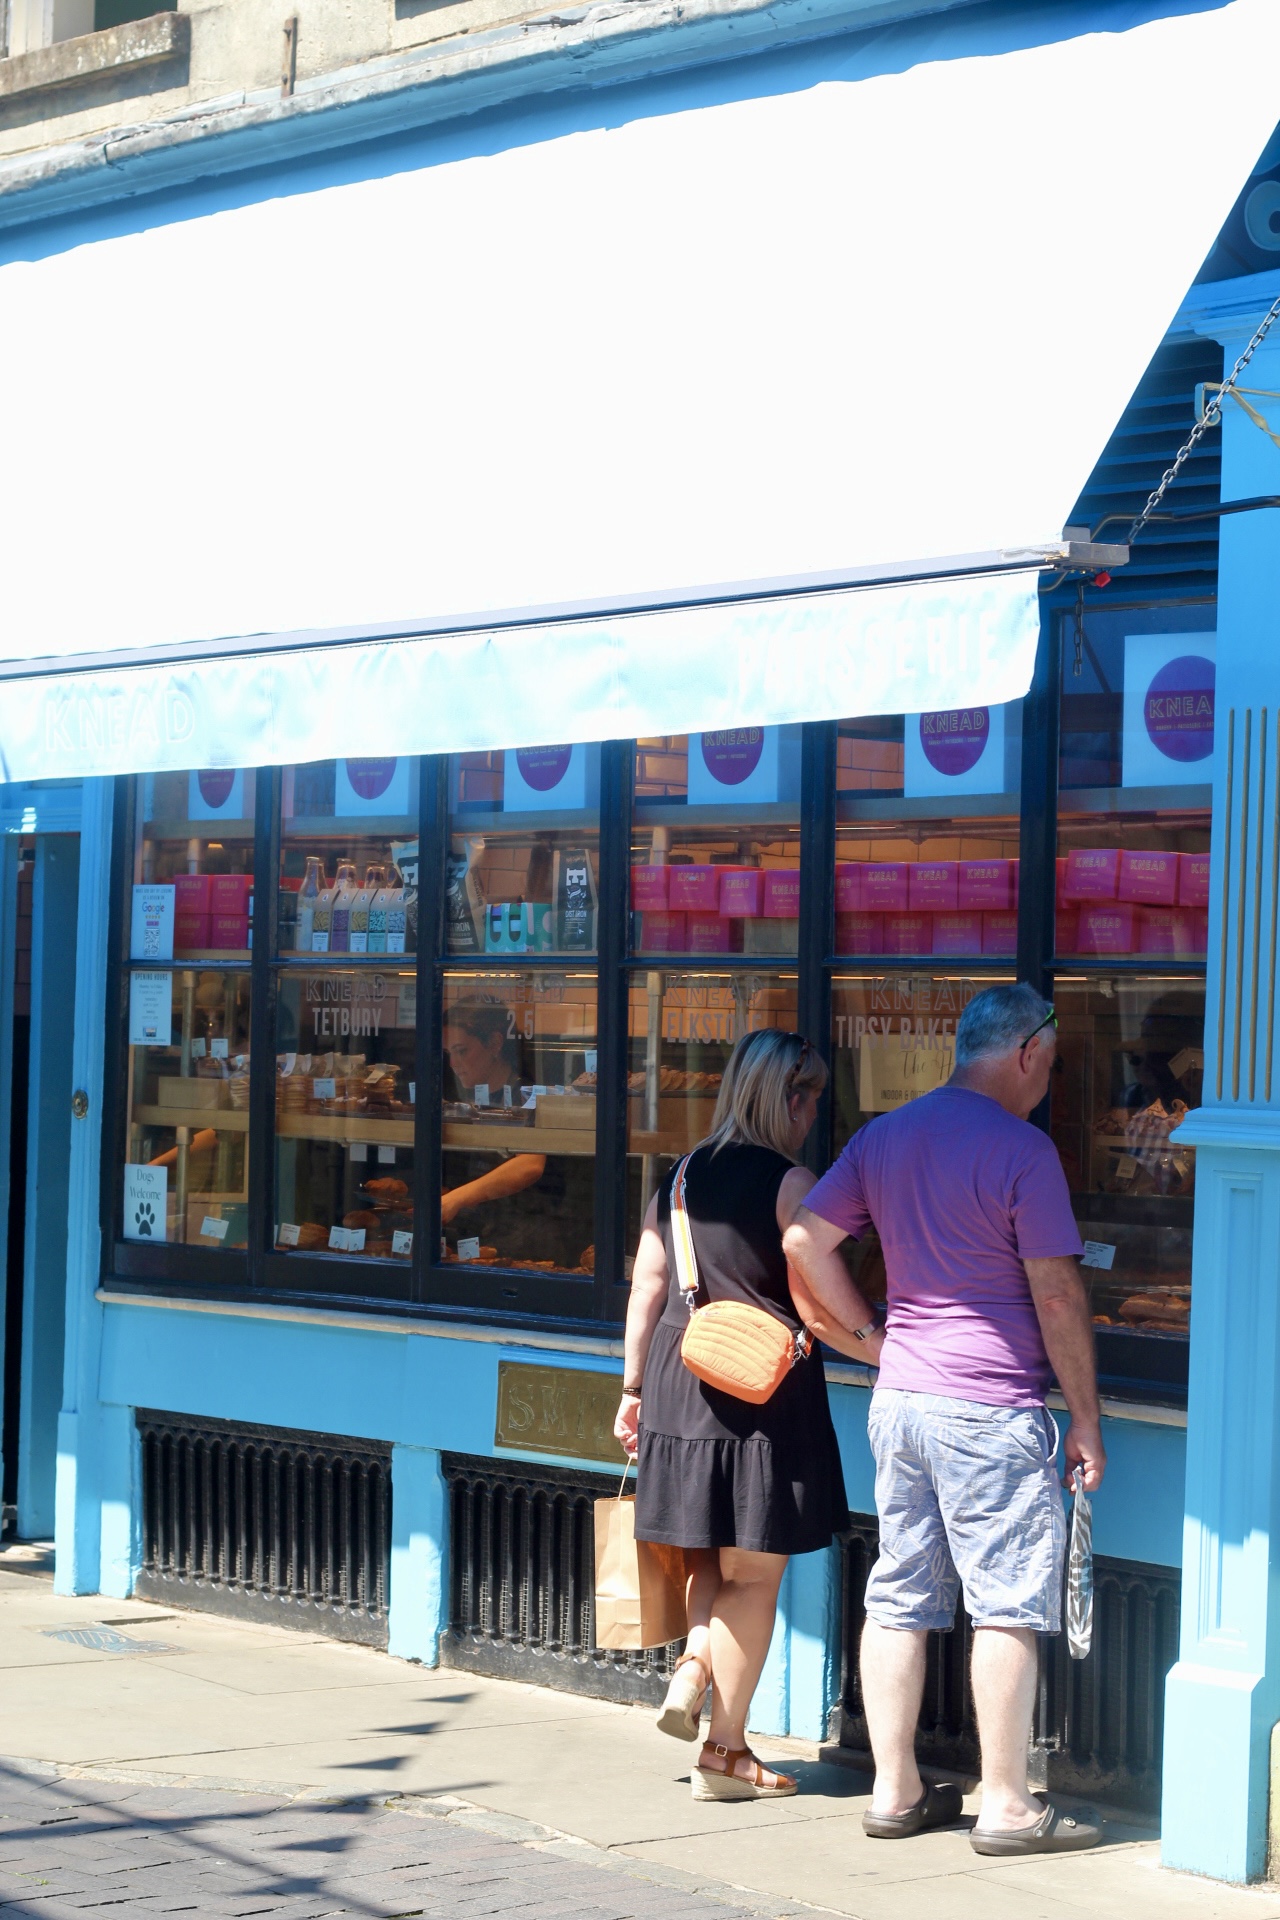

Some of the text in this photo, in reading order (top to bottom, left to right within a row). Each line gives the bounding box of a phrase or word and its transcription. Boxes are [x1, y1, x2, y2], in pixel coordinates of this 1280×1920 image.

[737, 609, 999, 692] PATISSERIE
[1149, 696, 1212, 719] KNEA
[45, 690, 196, 752] KNEAD
[923, 711, 985, 734] KNEAD
[704, 727, 760, 747] KNEAD
[966, 868, 999, 880] KNEAD
[1075, 857, 1107, 868] KNEAD
[1130, 859, 1167, 872] KNEAD
[868, 871, 898, 882] KNEAD
[917, 870, 949, 881] KNEAD
[142, 901, 165, 915] Google
[991, 918, 1017, 929] KNEA
[1087, 917, 1122, 929] KNEAD
[306, 974, 388, 1002] KNEAD
[475, 973, 566, 1004] KNEAD
[665, 975, 764, 1008] KNEAD
[871, 977, 977, 1011] KNEAD
[312, 1007, 382, 1037] TETBURY
[506, 1010, 534, 1040] 2.5
[836, 1015, 893, 1049] TIPSY
[899, 1050, 928, 1079] The
[881, 1089, 903, 1101] INDOOR
[136, 1168, 155, 1185] Dogs
[129, 1186, 161, 1201] Welcome
[508, 1384, 617, 1440] SMIT
